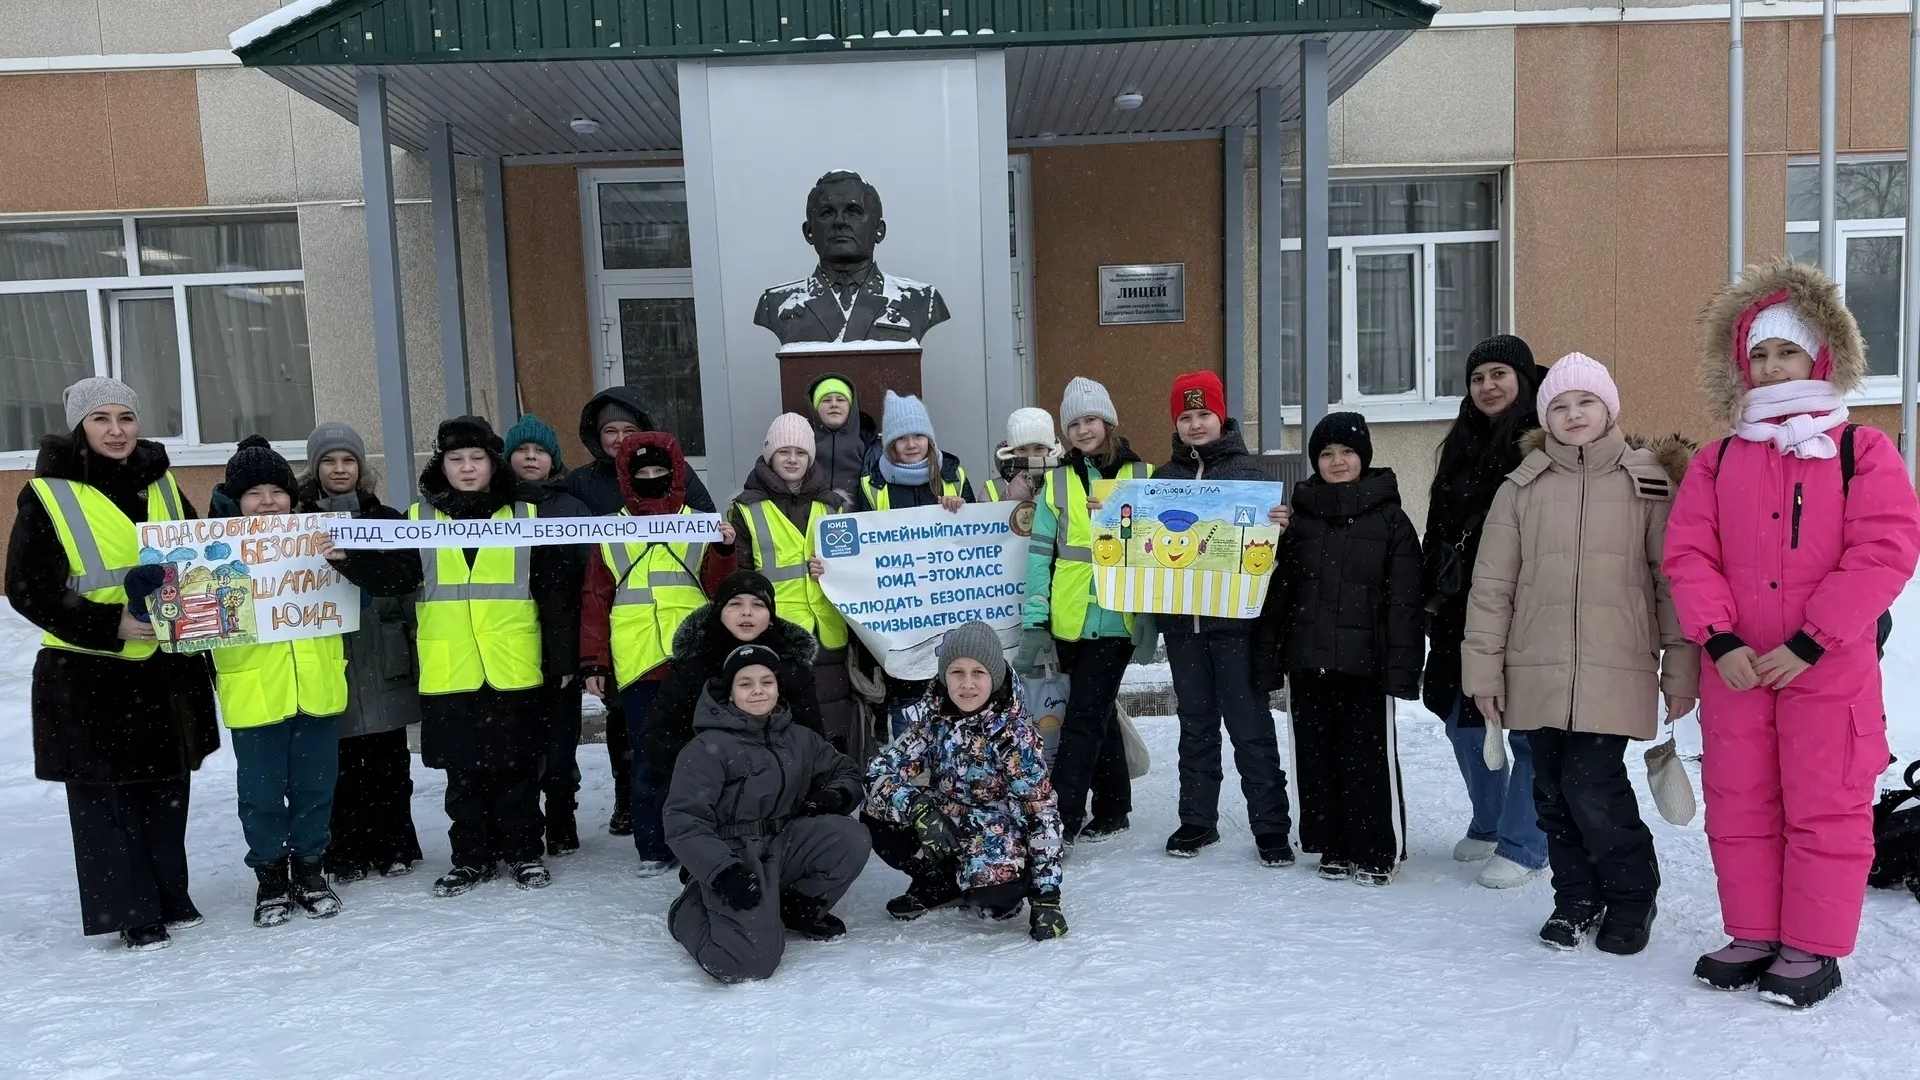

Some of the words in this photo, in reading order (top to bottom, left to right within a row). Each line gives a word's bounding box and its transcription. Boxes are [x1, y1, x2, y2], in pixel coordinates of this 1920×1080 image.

[1117, 284, 1167, 299] ЛИЦЕЙ
[1144, 482, 1196, 501] Соблюдай
[827, 521, 848, 529] ЮИД
[241, 530, 323, 566] БЕЗОПА
[958, 545, 1002, 560] СУПЕР
[833, 595, 923, 614] ОБЛЮДАТЬ
[931, 582, 1026, 605] БЕЗОПАСНОС
[272, 601, 342, 631] ЮИД
